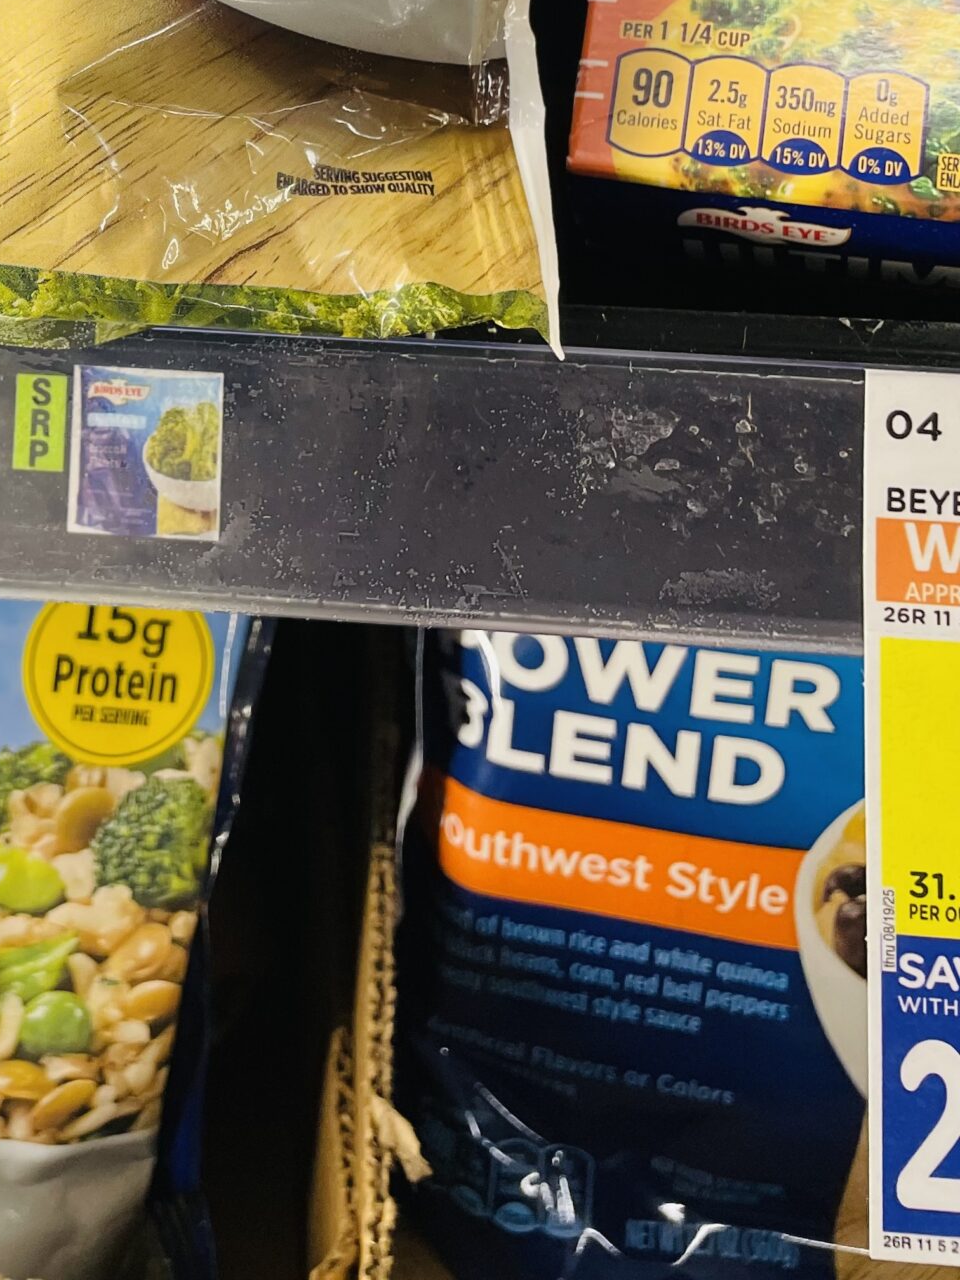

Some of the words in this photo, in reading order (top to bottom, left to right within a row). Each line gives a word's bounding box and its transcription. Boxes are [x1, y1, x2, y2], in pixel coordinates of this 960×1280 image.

[623, 22, 653, 39] PER
[661, 21, 668, 40] 1
[681, 22, 712, 44] 1/4
[718, 31, 750, 47] CUP
[632, 68, 673, 108] 90
[707, 79, 748, 108] 2.5g
[876, 79, 898, 107] 0g
[775, 85, 837, 118] 350mg
[616, 110, 678, 131] Calories
[697, 110, 725, 127] Sat.
[728, 113, 752, 131] Fat
[858, 106, 910, 126] Added
[772, 118, 832, 138] Sodium
[854, 124, 911, 145] Sugars
[696, 138, 726, 157] 13%
[730, 143, 747, 159] DV
[775, 147, 804, 166] 15%
[808, 152, 826, 168] DV
[314, 164, 360, 183] SERVING
[362, 171, 432, 183] SUGGESTION
[857, 156, 880, 174] 0%
[884, 161, 903, 177] DV
[331, 184, 348, 196] TO
[350, 183, 385, 195] SHOW
[388, 182, 435, 196] QUALITY
[696, 212, 775, 235] BIRDS
[886, 410, 942, 442] 04
[884, 607, 926, 625] 26R
[934, 611, 950, 627] 11
[52, 653, 178, 703] Protein
[461, 631, 840, 733] OWER
[666, 861, 788, 915] Style
[883, 890, 895, 942] 08/19/25
[909, 904, 940, 922] PER
[884, 945, 896, 968] thru
[898, 996, 959, 1017] WITH
[884, 1235, 911, 1249] 26R
[918, 1239, 931, 1251] 11
[938, 1240, 946, 1252] 5
[951, 1241, 959, 1254] 2
